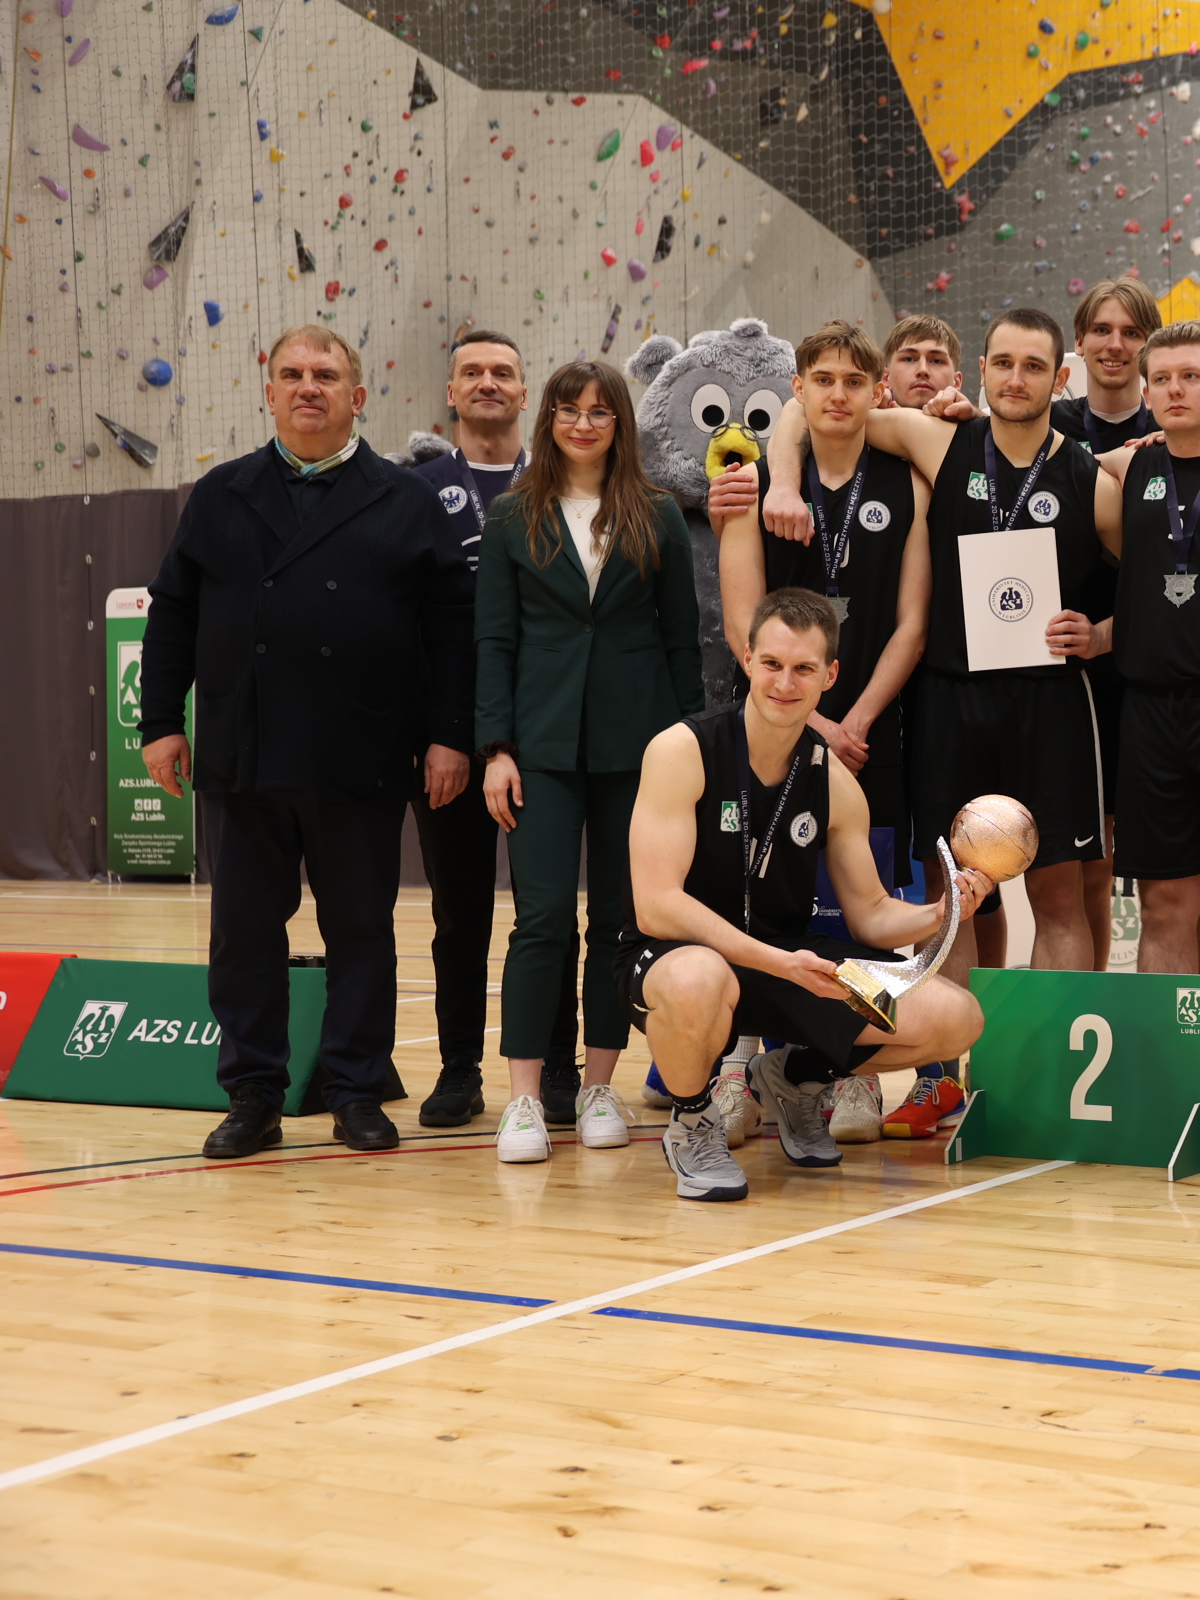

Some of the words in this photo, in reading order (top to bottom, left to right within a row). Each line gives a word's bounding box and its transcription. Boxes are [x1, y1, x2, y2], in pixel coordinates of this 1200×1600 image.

[146, 813, 166, 821] Lublin
[127, 1018, 182, 1044] AZS
[1069, 1013, 1113, 1122] 2
